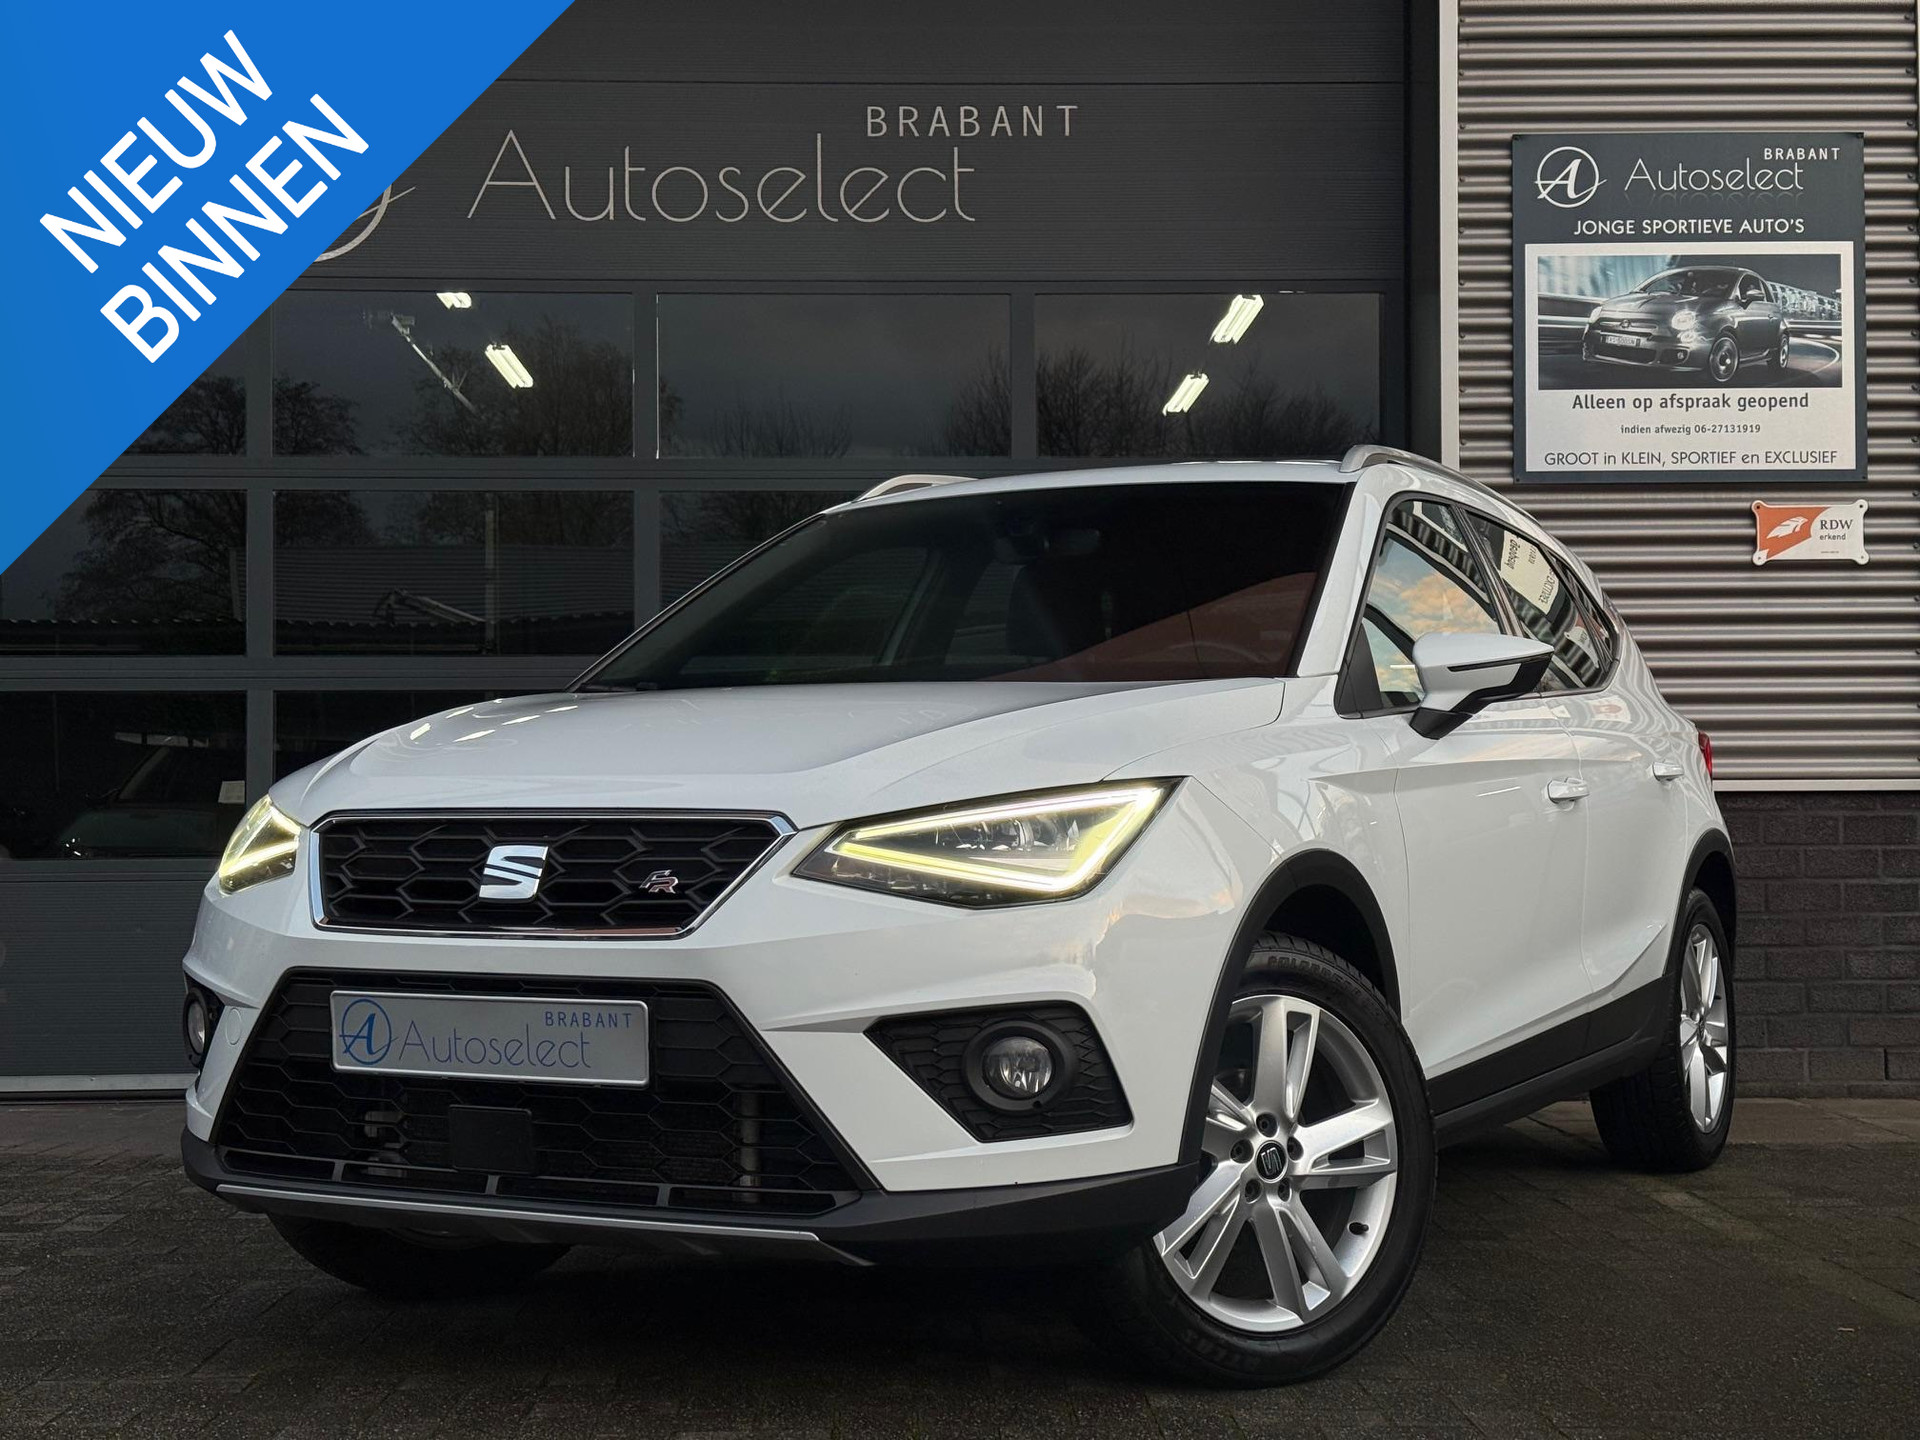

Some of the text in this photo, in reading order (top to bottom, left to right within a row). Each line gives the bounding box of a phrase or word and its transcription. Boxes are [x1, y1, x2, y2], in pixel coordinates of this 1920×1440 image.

[867, 105, 1079, 137] BRABANT
[1763, 147, 1841, 161] BRABANT
[467, 129, 977, 223] Autoselect
[1624, 157, 1804, 191] Autoselect
[1573, 217, 1806, 236] JONGE SPORTIEVE AUTO'S
[1571, 392, 1810, 413] Alleen op afspraak geopend
[1619, 423, 1761, 436] indien afwezig 06-27131919
[1544, 449, 1838, 468] GROOT in KLEIN, SPORTIEF en EXCLUSIEF
[1820, 519, 1853, 530] RDW
[1819, 533, 1846, 541] erkend
[545, 1011, 632, 1029] BRABANT
[399, 1020, 592, 1069] Autoselect
